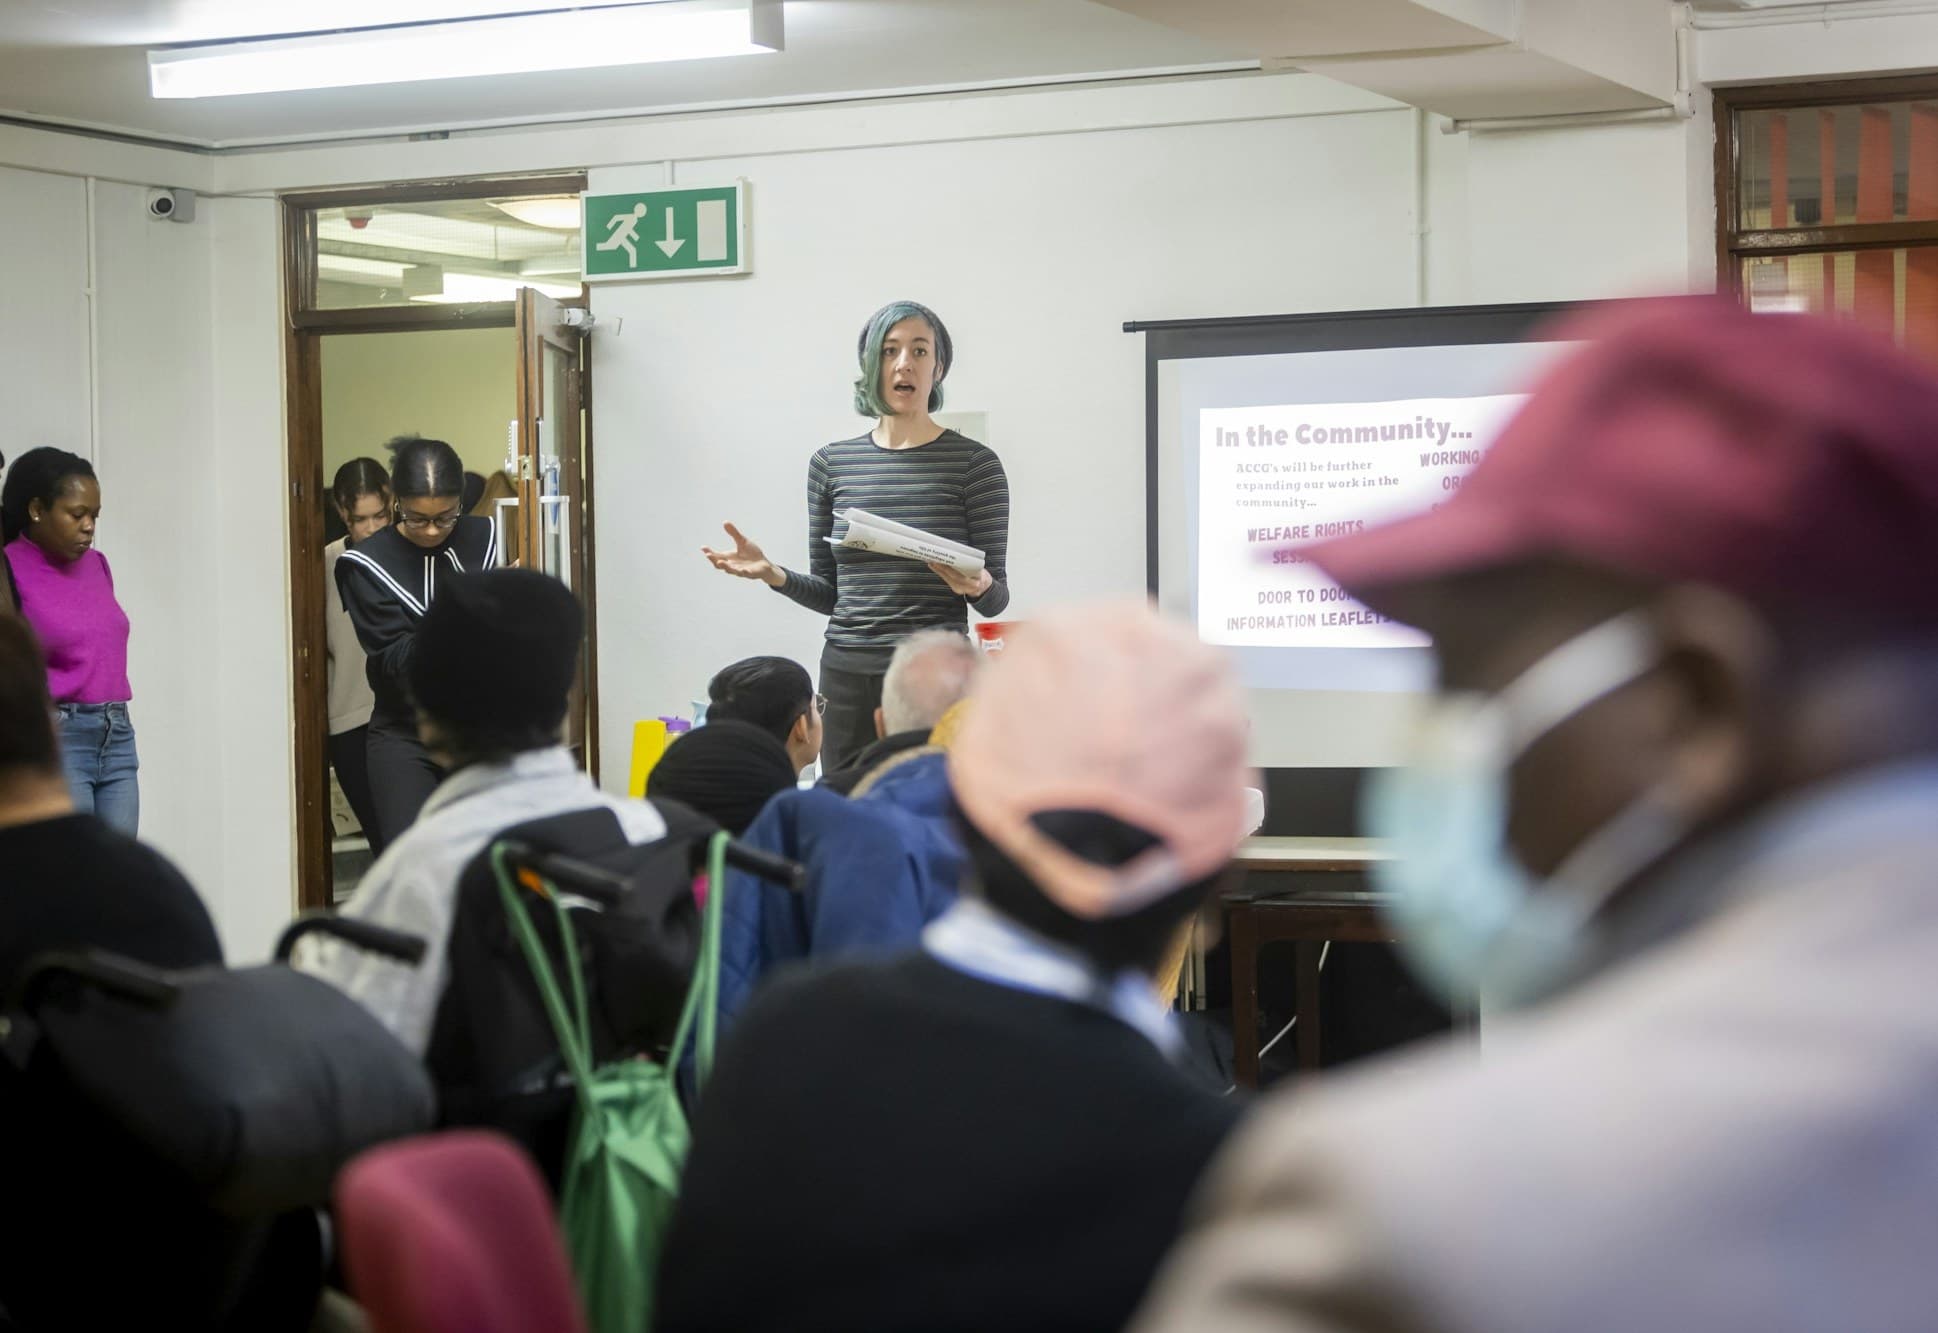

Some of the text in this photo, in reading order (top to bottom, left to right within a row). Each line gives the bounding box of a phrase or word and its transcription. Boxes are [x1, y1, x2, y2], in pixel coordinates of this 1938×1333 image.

[1216, 416, 1472, 447] In the Community...
[1420, 450, 1480, 467] WORKING
[1282, 462, 1307, 473] will
[1310, 462, 1324, 472] be
[1327, 461, 1373, 472] further
[1236, 476, 1399, 492] expanding our work in the
[1236, 497, 1317, 509] community...
[1247, 520, 1364, 542] WELFARE RIGHTS
[1273, 550, 1307, 564] SES
[1258, 590, 1292, 605] DOOR
[1297, 589, 1315, 602] TO
[1227, 614, 1316, 631] INFORMATION
